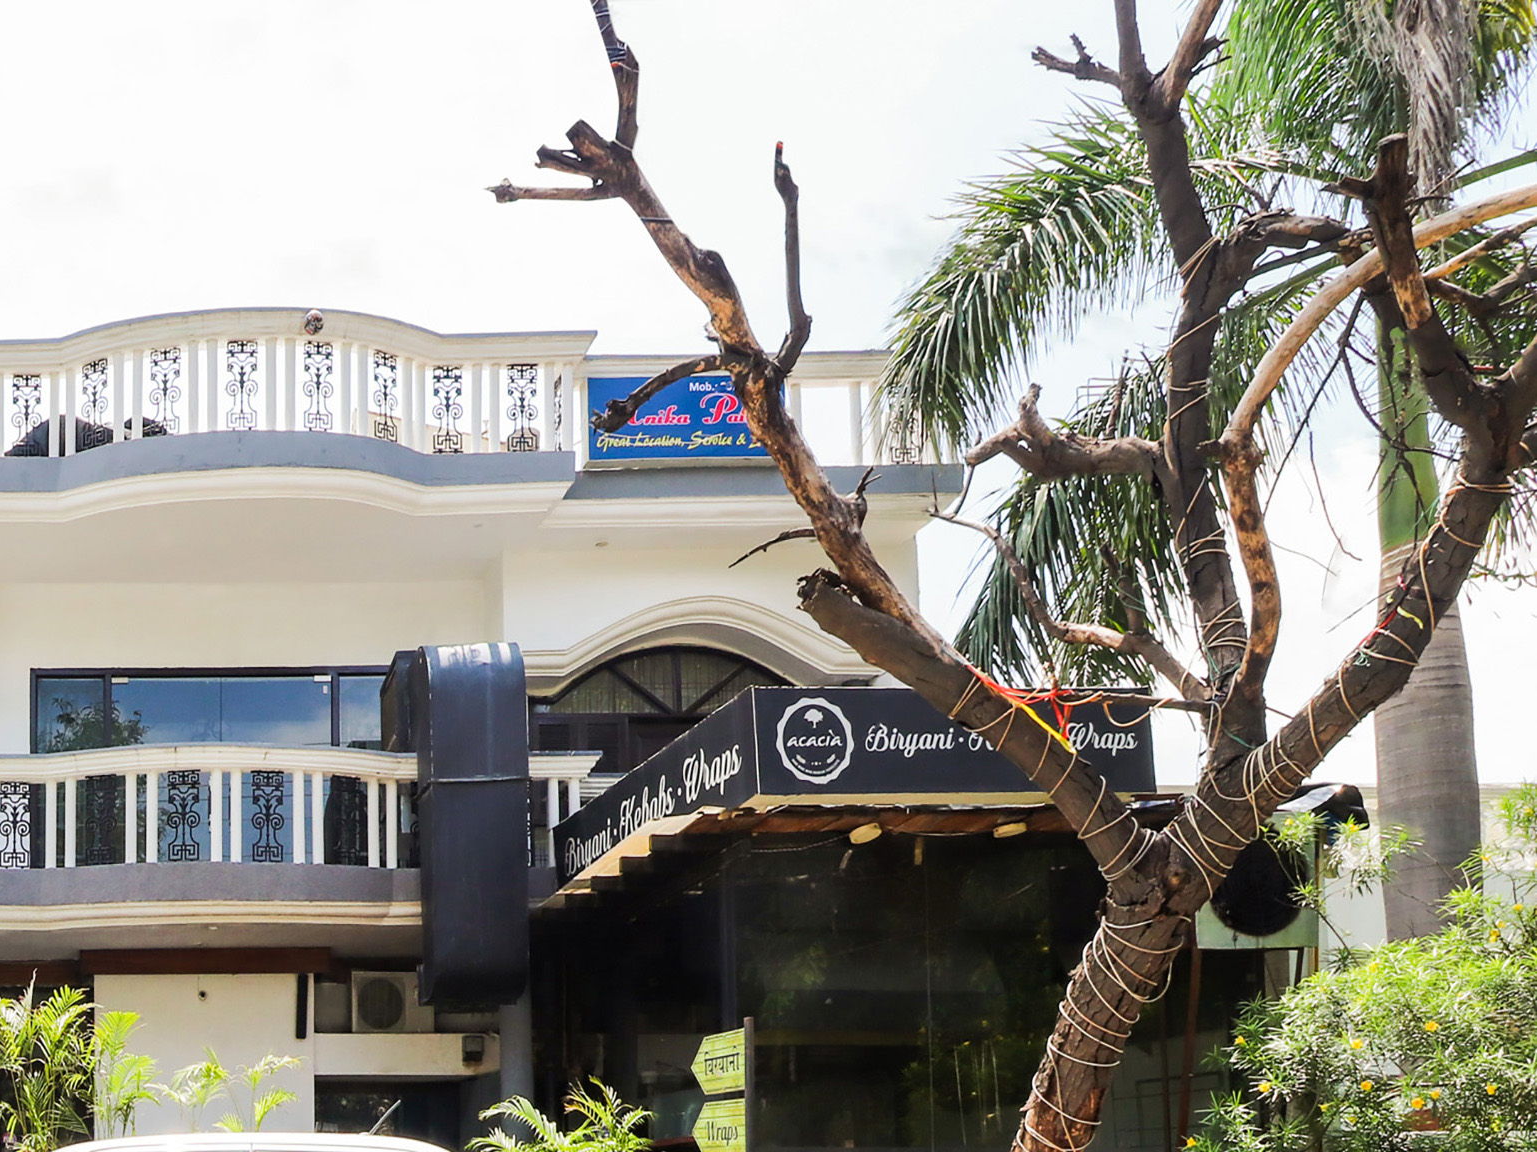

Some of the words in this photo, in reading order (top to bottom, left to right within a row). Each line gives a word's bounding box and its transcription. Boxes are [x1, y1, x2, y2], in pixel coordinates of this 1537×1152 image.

[626, 405, 691, 426] nika
[736, 433, 746, 445] &
[865, 723, 954, 758] Biryani
[1066, 722, 1138, 756] Wraps
[565, 818, 612, 876] Biryani
[620, 774, 675, 841] Kebabs
[683, 744, 742, 804] Wraps
